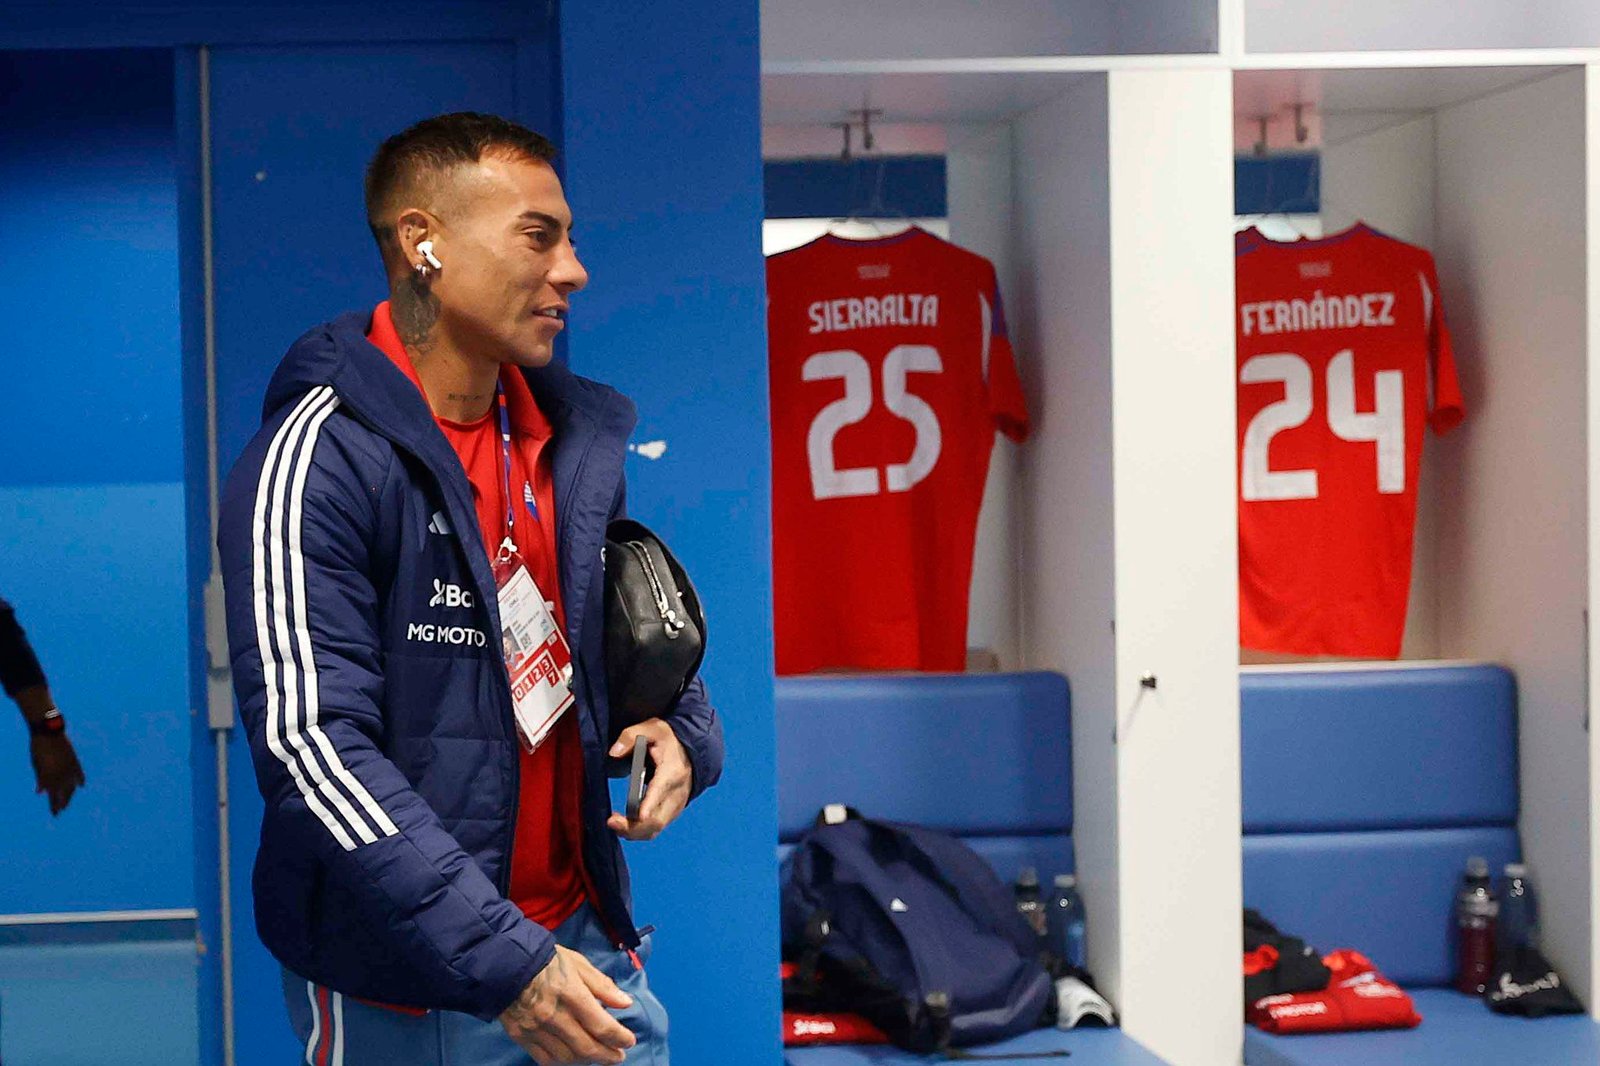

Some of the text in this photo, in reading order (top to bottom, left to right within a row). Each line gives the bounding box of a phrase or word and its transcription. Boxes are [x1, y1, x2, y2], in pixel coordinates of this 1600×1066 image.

[808, 294, 939, 334] SIERRALTA
[1241, 289, 1395, 336] FERNÁNDEZ
[802, 344, 944, 500] 25
[1239, 349, 1405, 502] 24
[407, 623, 488, 648] MG MOTO
[514, 659, 550, 700] 0 1 2 3
[548, 671, 556, 684] 7
